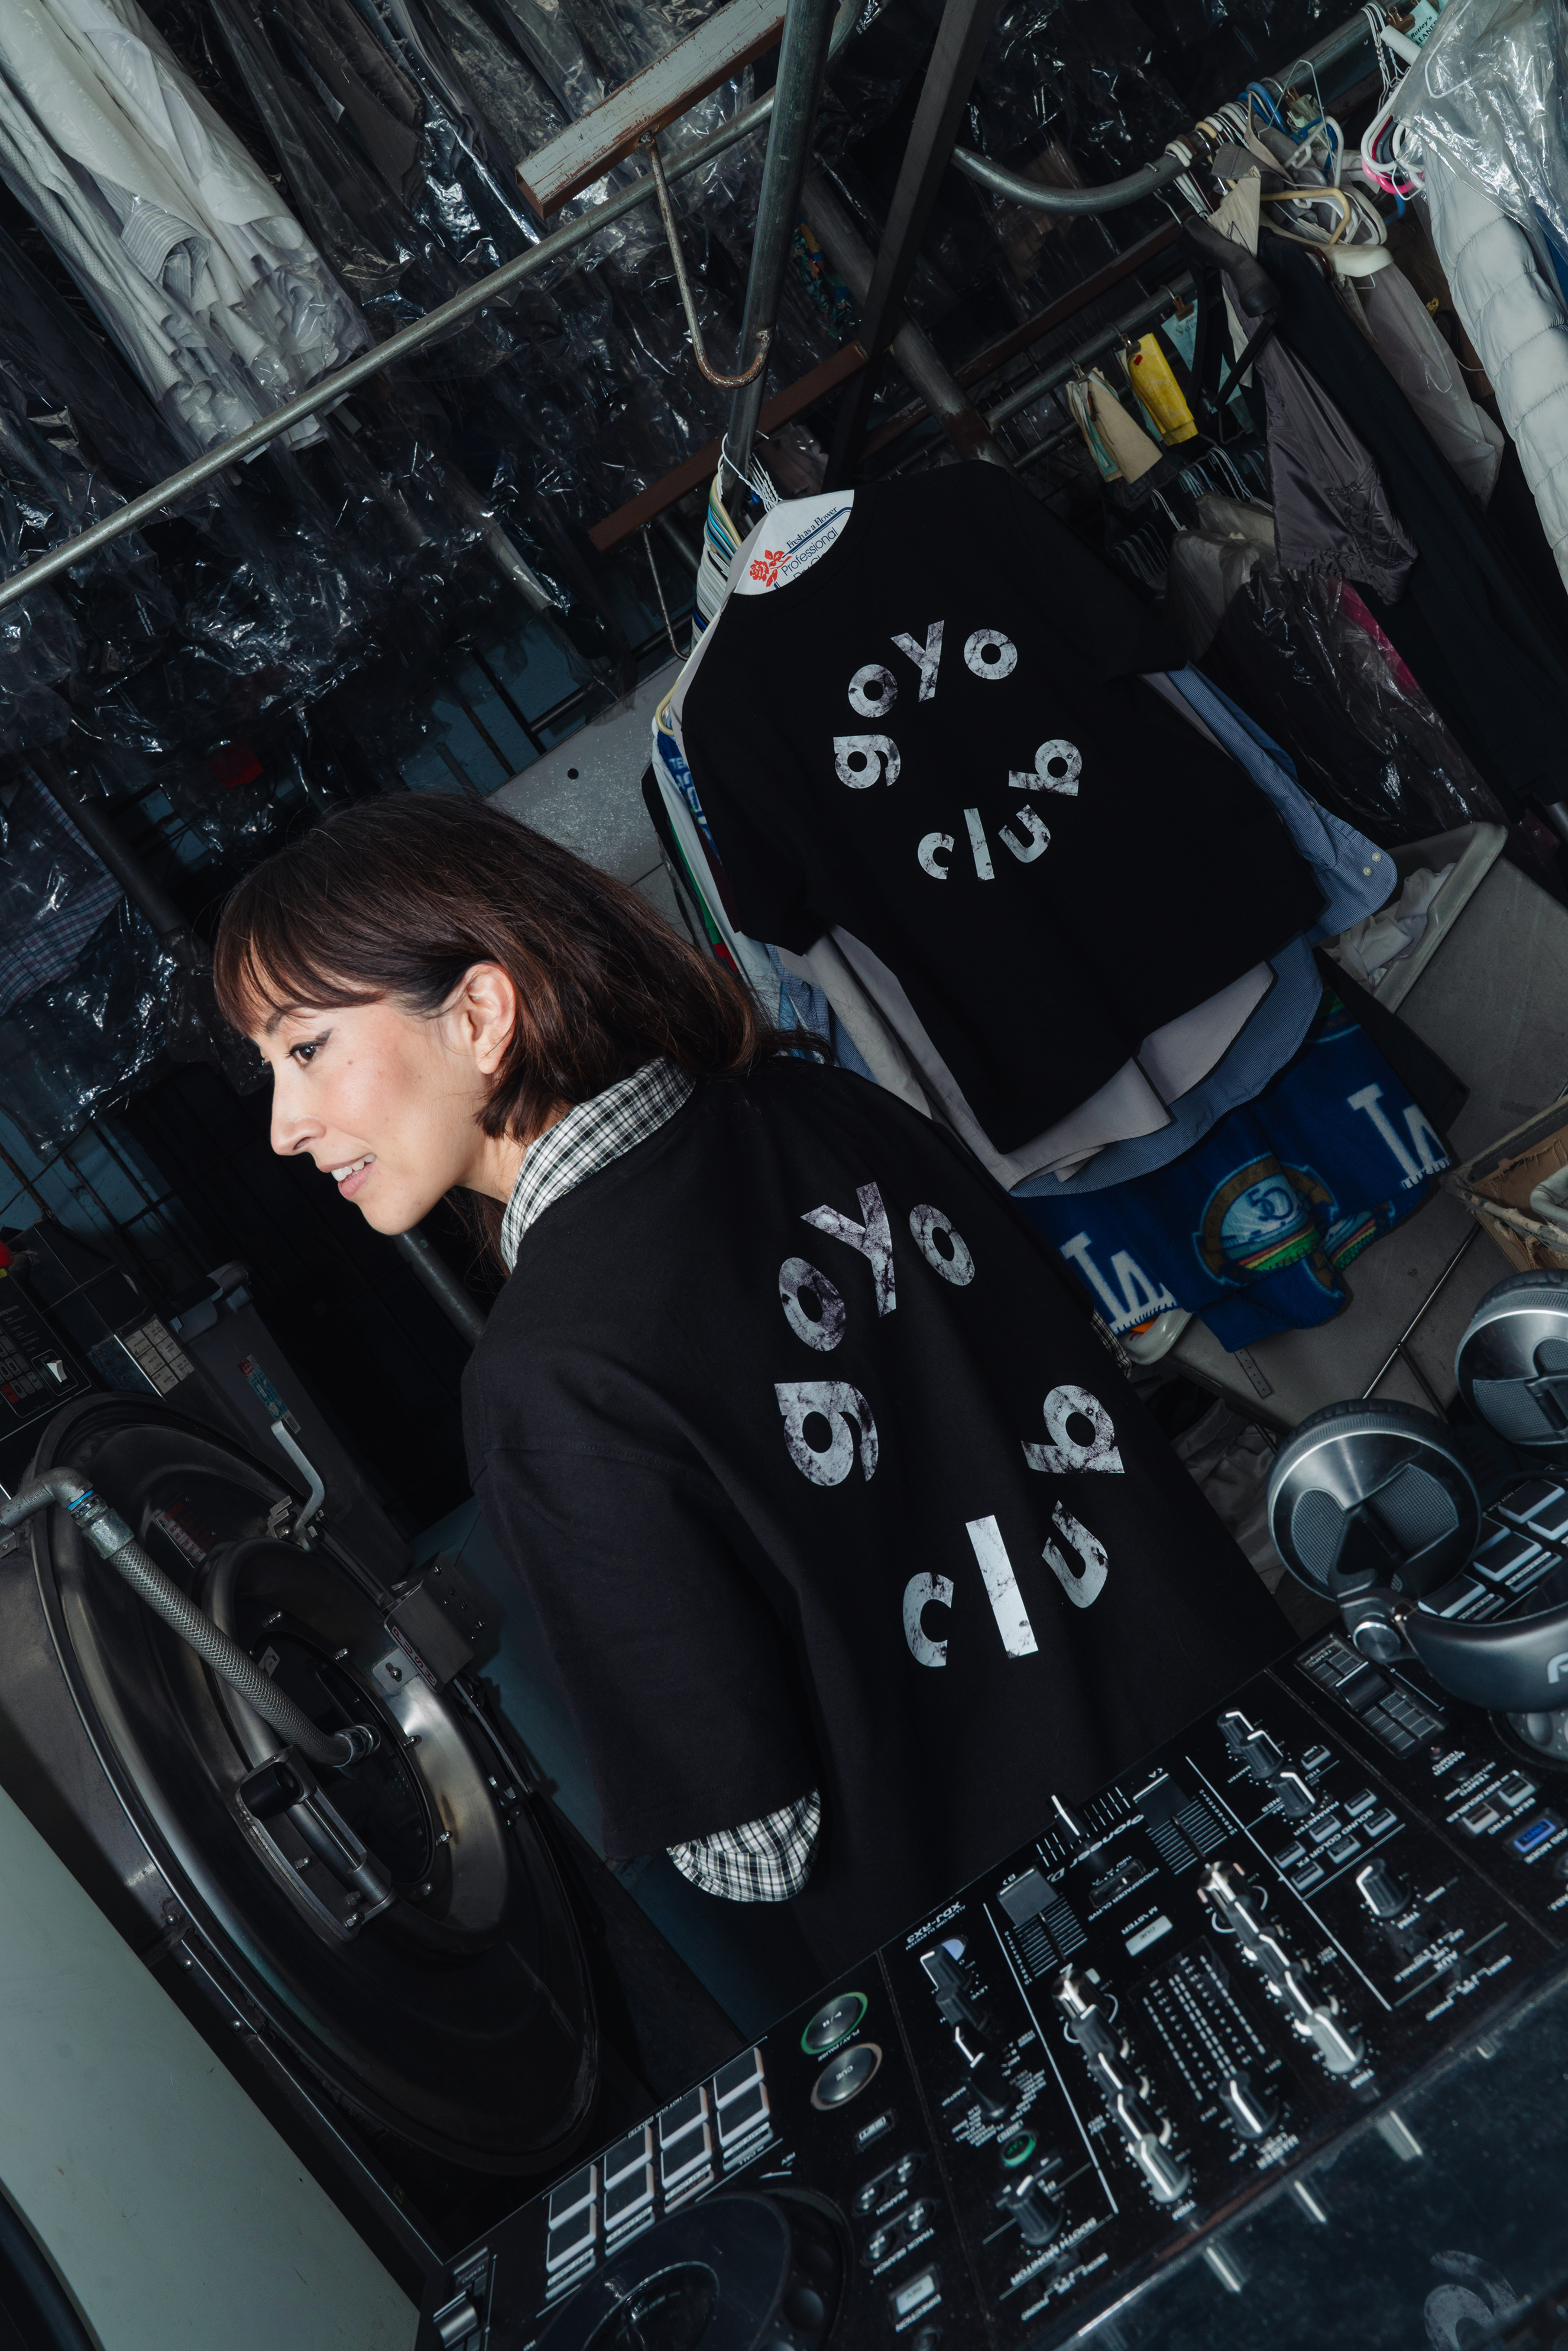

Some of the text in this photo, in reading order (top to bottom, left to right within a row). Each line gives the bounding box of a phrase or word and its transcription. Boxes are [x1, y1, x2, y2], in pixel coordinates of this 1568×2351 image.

[1407, 15, 1435, 38] Rutley's
[786, 533, 806, 549] Fresh
[803, 526, 812, 536] as
[814, 507, 838, 527] Flower
[780, 526, 839, 577] Professional
[917, 739, 1083, 882] club
[8, 1361, 17, 1371] 9
[14, 1384, 22, 1394] 0
[902, 1384, 1126, 1667] club
[392, 1626, 435, 1684] PUSH
[1430, 1748, 1459, 1772] TEMPO
[1433, 1750, 1466, 1777] MASTER
[1457, 1771, 1491, 1798] TEMPO
[1292, 1799, 1340, 1838] PARAMETER
[1486, 1795, 1537, 1836] BEAT SYNC
[1295, 1808, 1374, 1869] SOUND COLOR FX
[1522, 1840, 1553, 1866] MODE
[1110, 1866, 1160, 1904] CROSSFADER
[904, 1900, 963, 1944] XDJ-RX3
[934, 1904, 967, 1929] ALL-IN-ONE
[903, 1932, 928, 1951] SYSTEM
[815, 2027, 861, 2064] PLAY/PAUSE
[834, 2064, 854, 2081] CUE
[939, 2085, 968, 2108] MASTER
[876, 2189, 908, 2214] SEARCH
[873, 2228, 934, 2275] TRACK SEARCH
[1006, 2216, 1099, 2287] BOOTH MONITOR
[896, 2294, 941, 2331] DIRECTION
